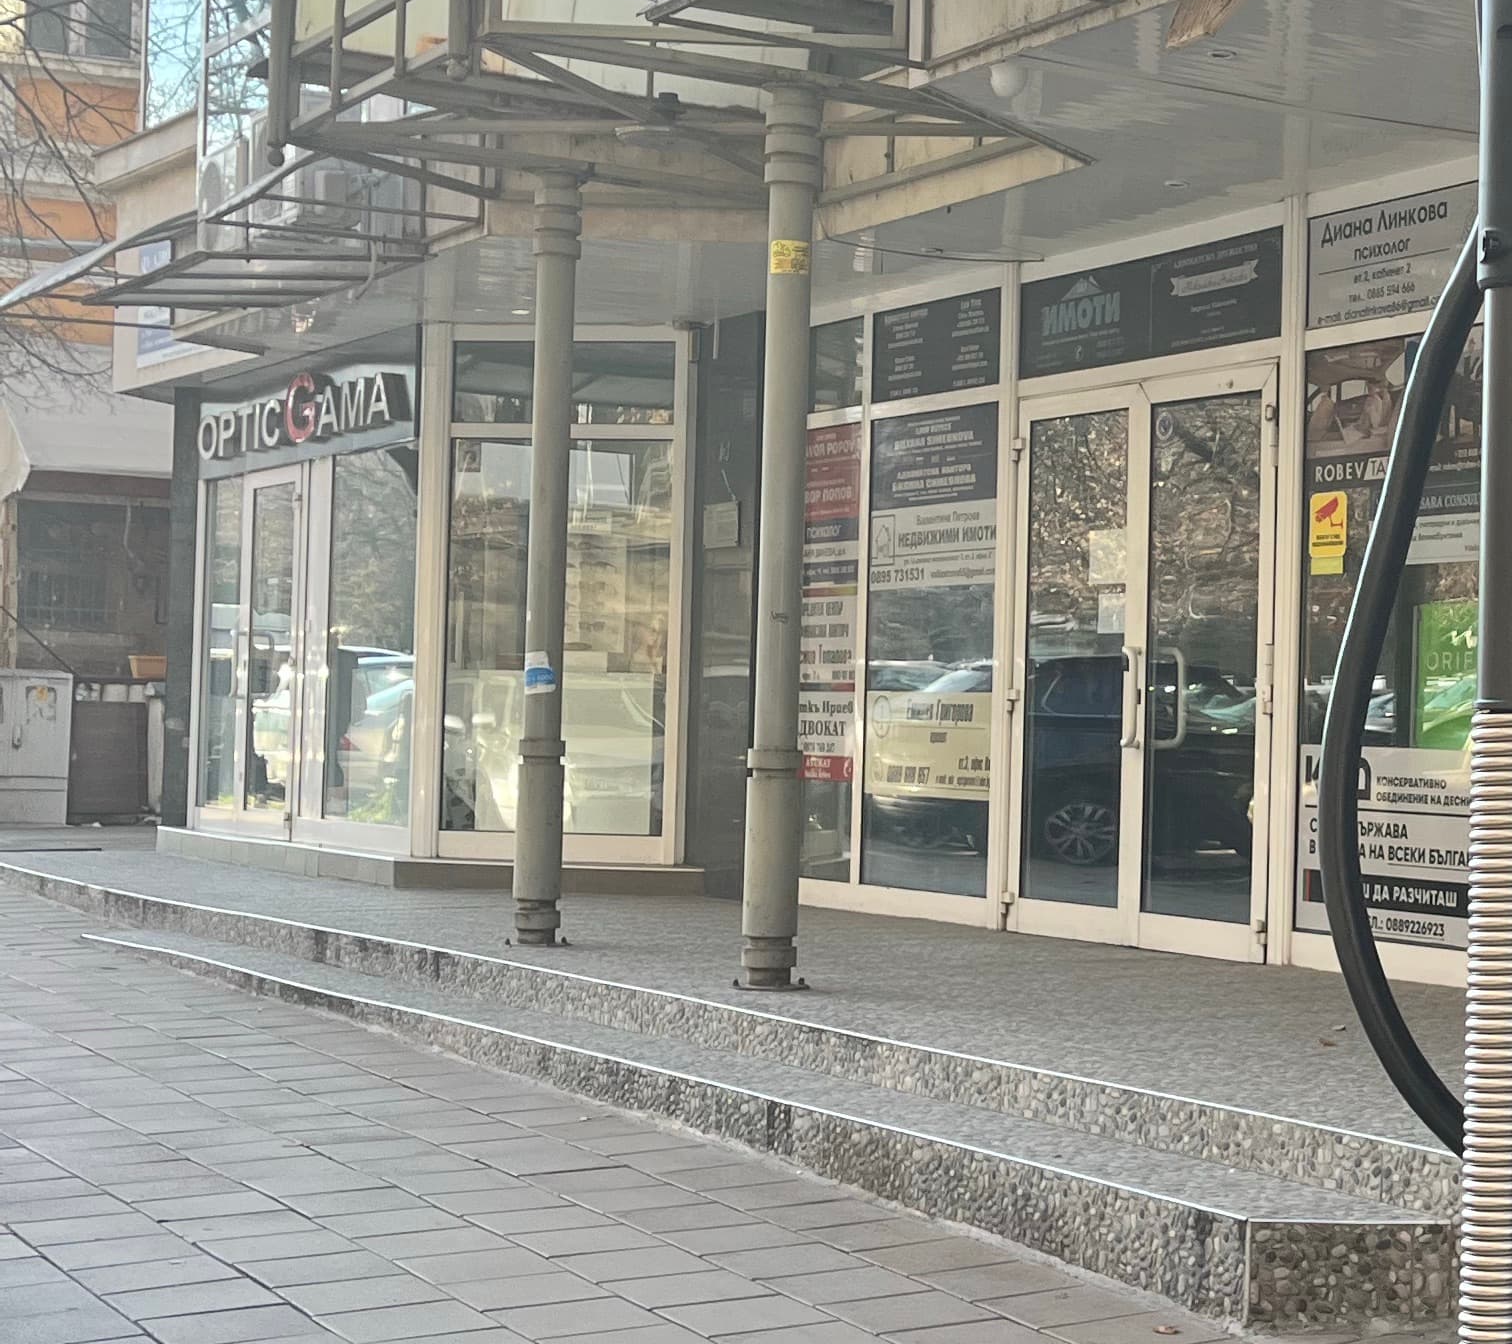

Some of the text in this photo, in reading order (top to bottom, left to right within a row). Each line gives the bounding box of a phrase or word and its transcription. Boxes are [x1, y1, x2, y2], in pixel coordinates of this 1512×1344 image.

[1321, 201, 1449, 248] Диана Линкова
[1353, 237, 1411, 262] психолог
[1041, 292, 1121, 337] ИМОТИ
[198, 372, 391, 460] OPTIC GAMA
[1315, 461, 1365, 483] ROBEV
[898, 528, 960, 550] НЕДВИЖИМИ
[800, 720, 847, 739] ДВОКАТ
[1376, 775, 1447, 790] КОНСЕРВАТИВНО
[1376, 792, 1429, 805] ОБЕДИНЕНИЕ
[1430, 797, 1442, 806] НА
[1371, 845, 1386, 861] НА
[1388, 846, 1427, 864] ВСЕКИ
[1373, 884, 1458, 908] ДА РАЗЧИТАШ
[1385, 917, 1446, 938] 0889226923
